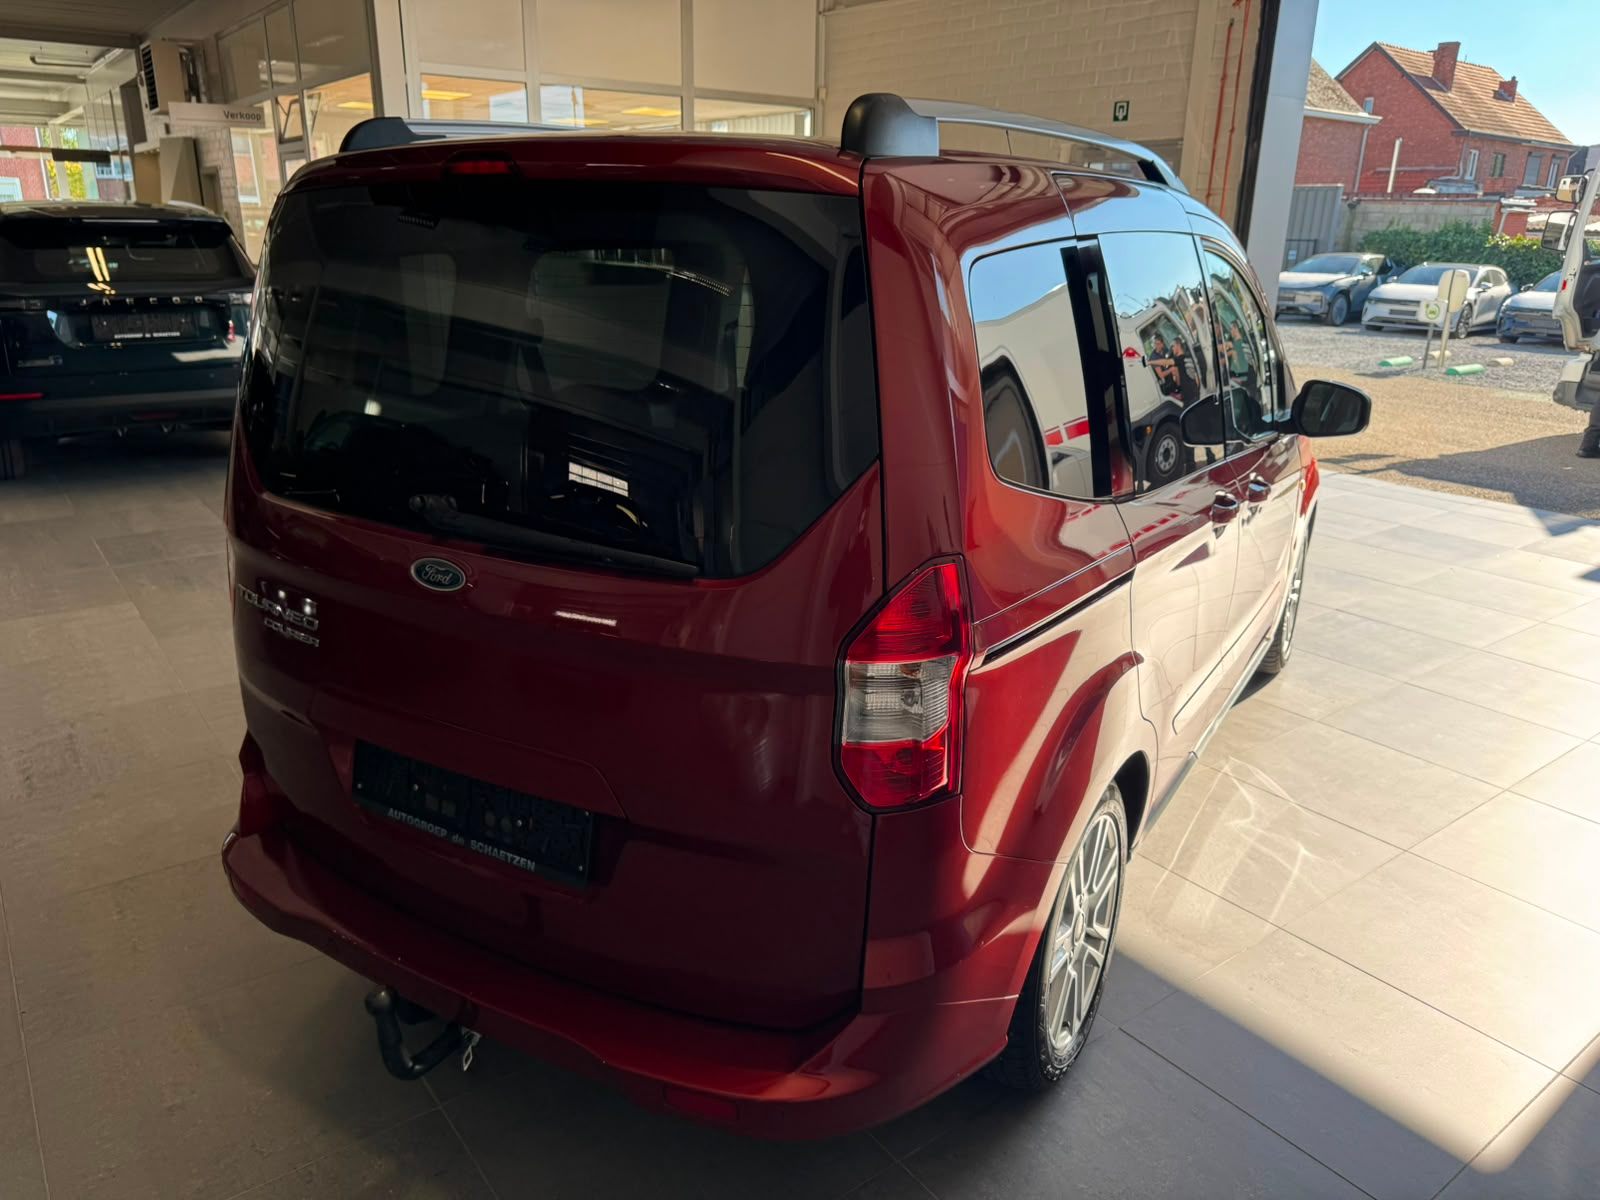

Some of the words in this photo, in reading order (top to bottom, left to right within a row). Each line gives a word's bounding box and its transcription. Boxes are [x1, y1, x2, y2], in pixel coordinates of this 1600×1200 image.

[223, 110, 262, 121] Verkoop
[422, 563, 453, 585] Ford
[239, 583, 319, 631] TOURNEO
[387, 807, 448, 838] AUTOGROEP
[470, 839, 536, 872] SCHAETZEN
